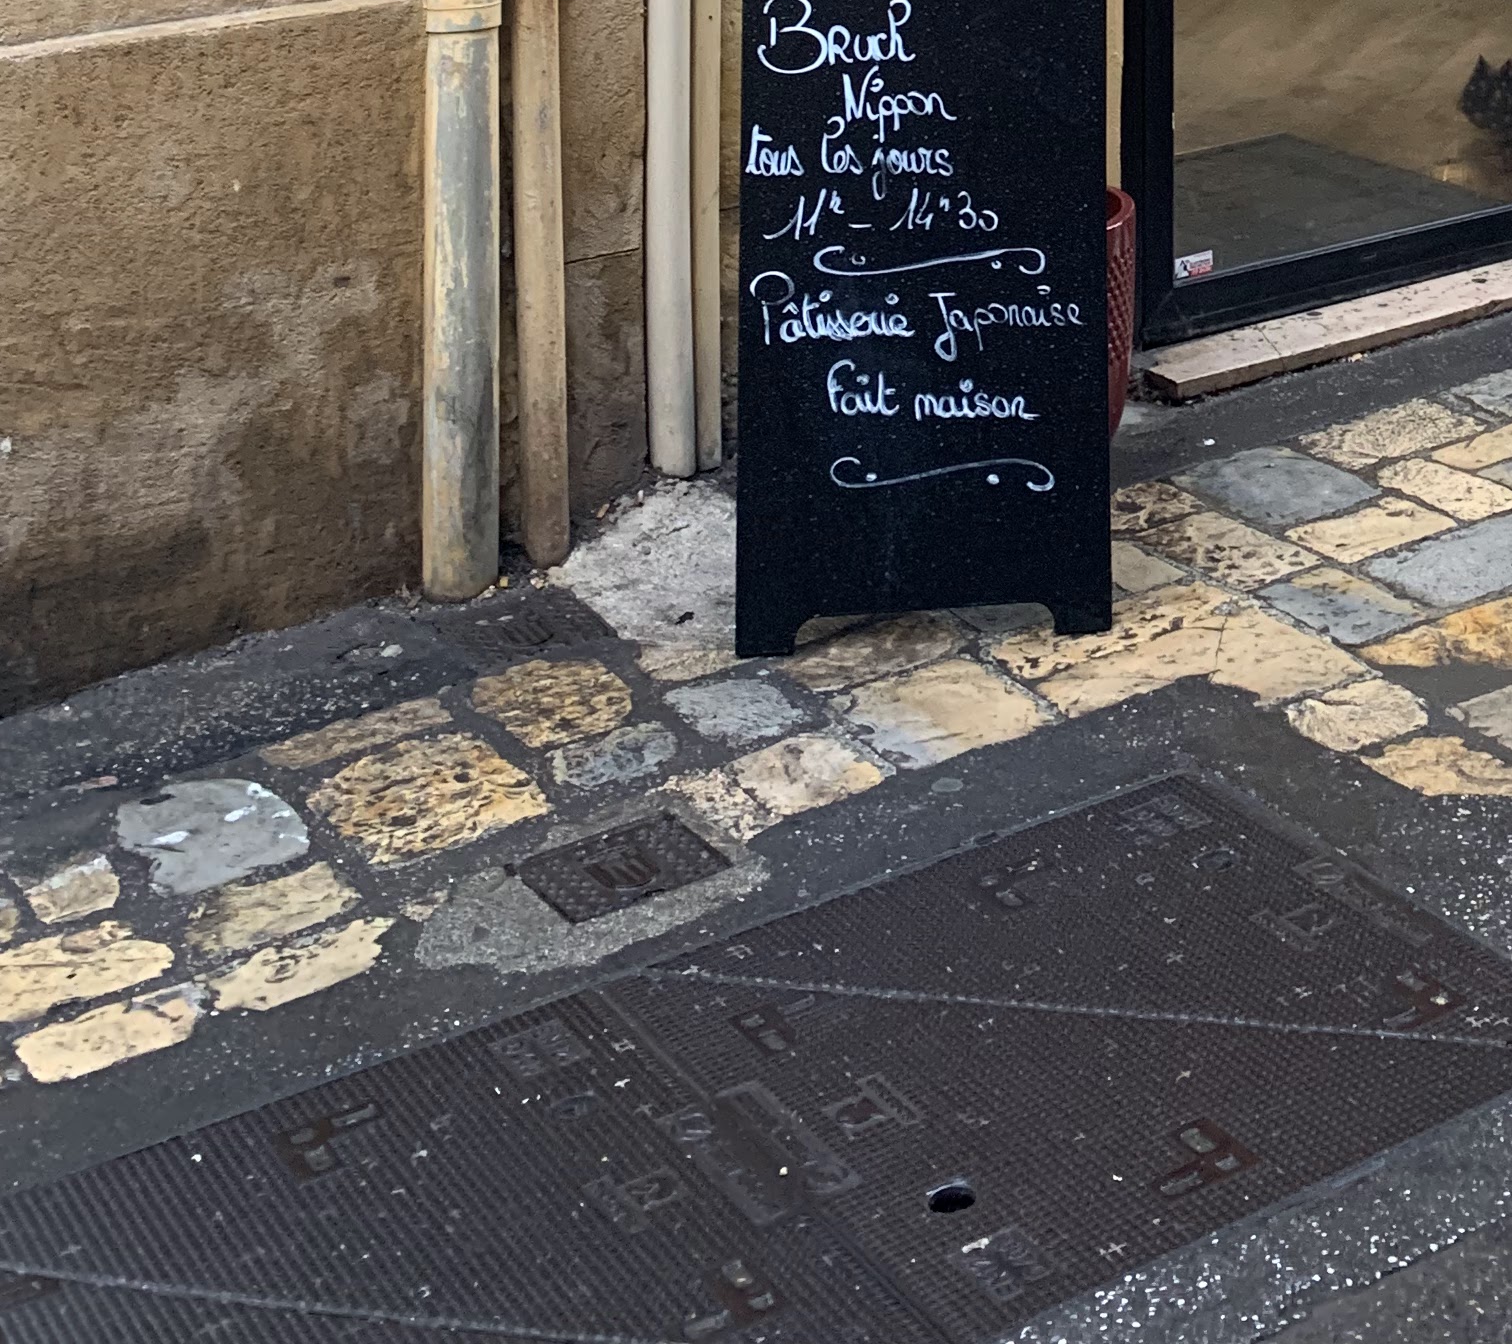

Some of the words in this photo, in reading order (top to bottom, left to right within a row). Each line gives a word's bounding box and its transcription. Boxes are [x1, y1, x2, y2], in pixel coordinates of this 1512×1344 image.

[842, 65, 957, 144] Nippon
[745, 124, 805, 177] tous
[821, 115, 863, 175] les
[871, 133, 954, 201] jours
[914, 378, 1041, 422] maison
